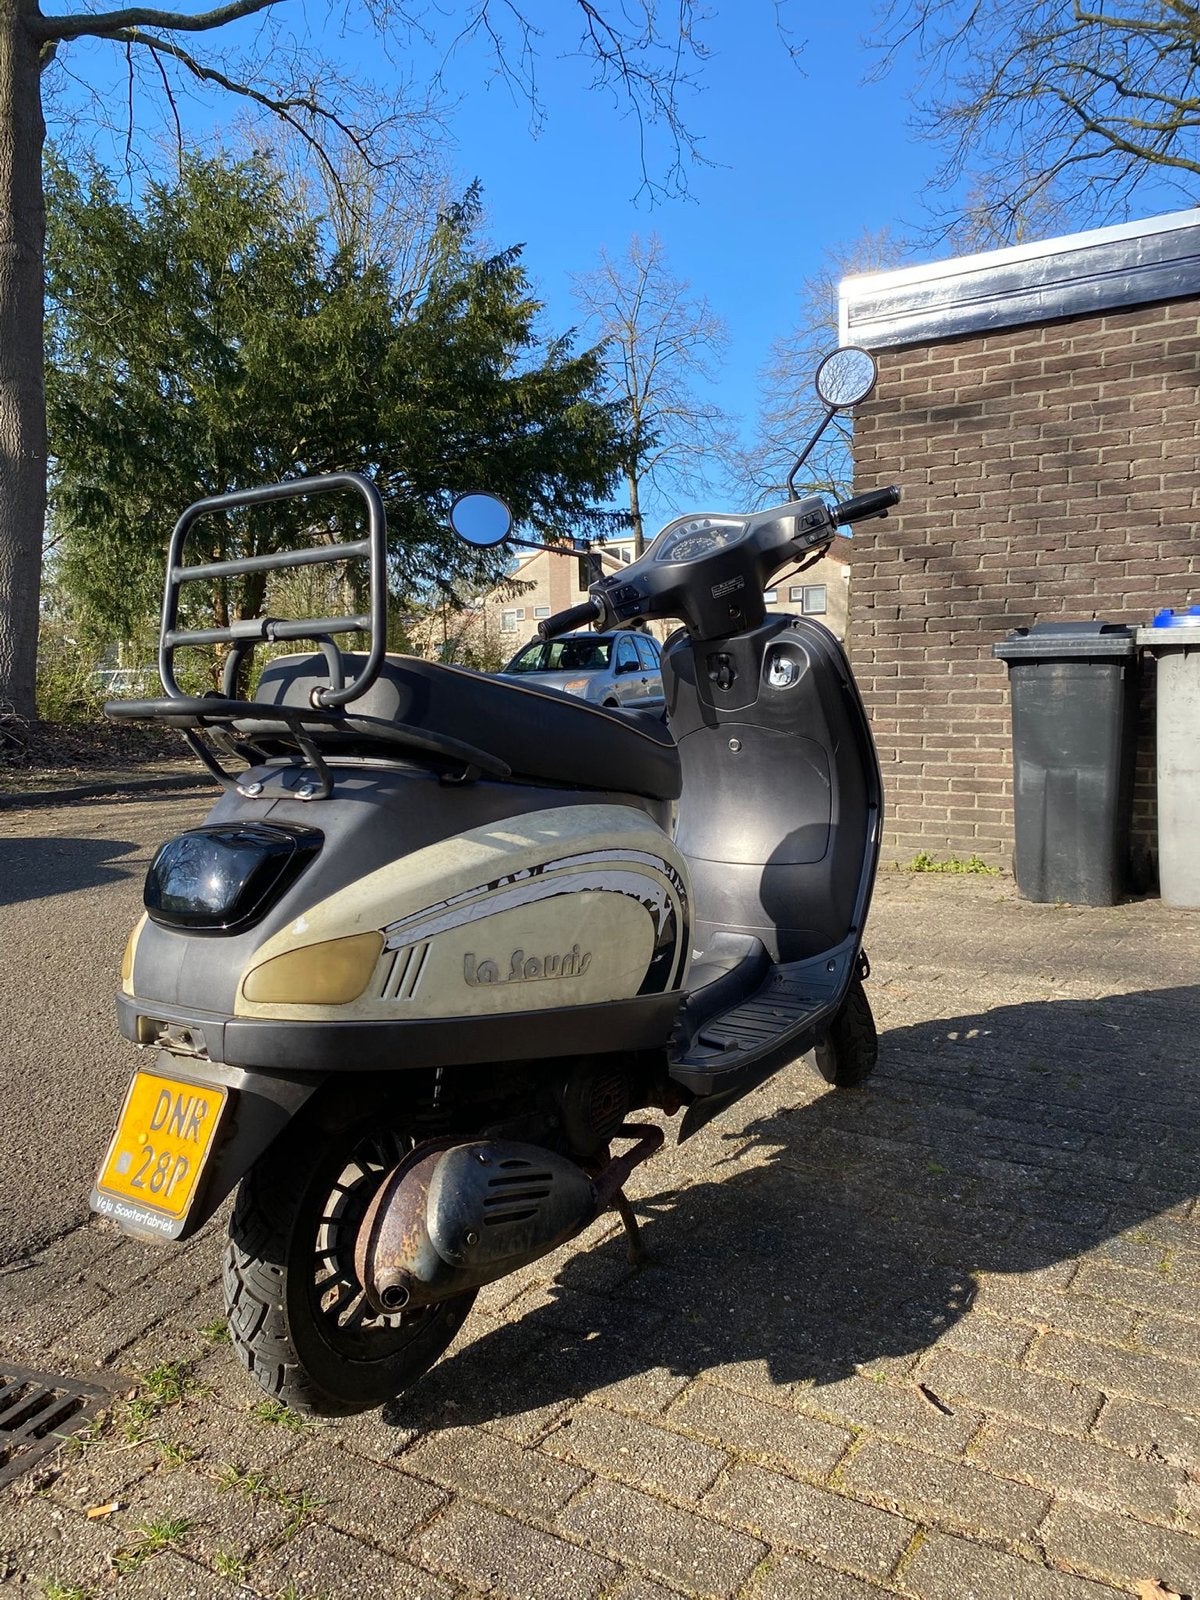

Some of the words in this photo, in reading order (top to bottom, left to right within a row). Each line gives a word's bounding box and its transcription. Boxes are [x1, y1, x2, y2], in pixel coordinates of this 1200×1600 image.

[150, 1089, 208, 1143] DNR
[131, 1145, 189, 1198] 28P
[115, 1203, 174, 1232] Scooterfabriek
